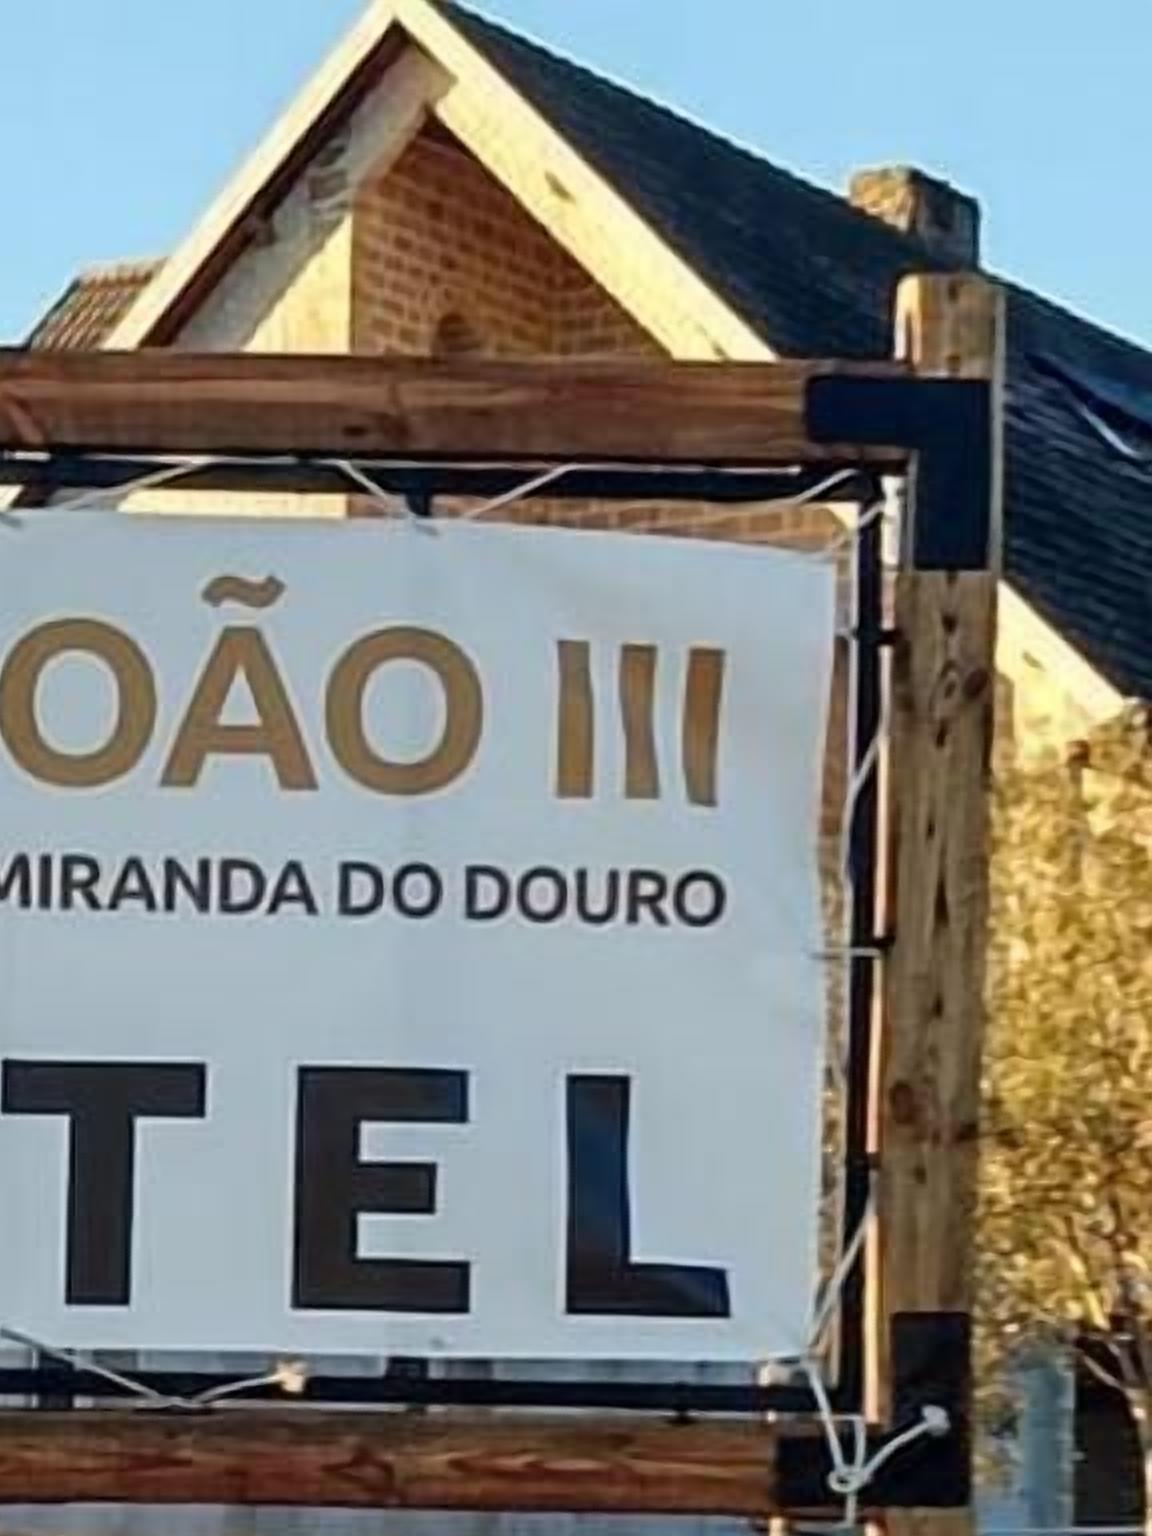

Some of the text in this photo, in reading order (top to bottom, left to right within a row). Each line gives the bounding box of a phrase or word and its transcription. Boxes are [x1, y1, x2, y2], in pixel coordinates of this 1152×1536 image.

[556, 638, 727, 808] III
[337, 860, 444, 920] DO
[464, 864, 727, 928] DOURO
